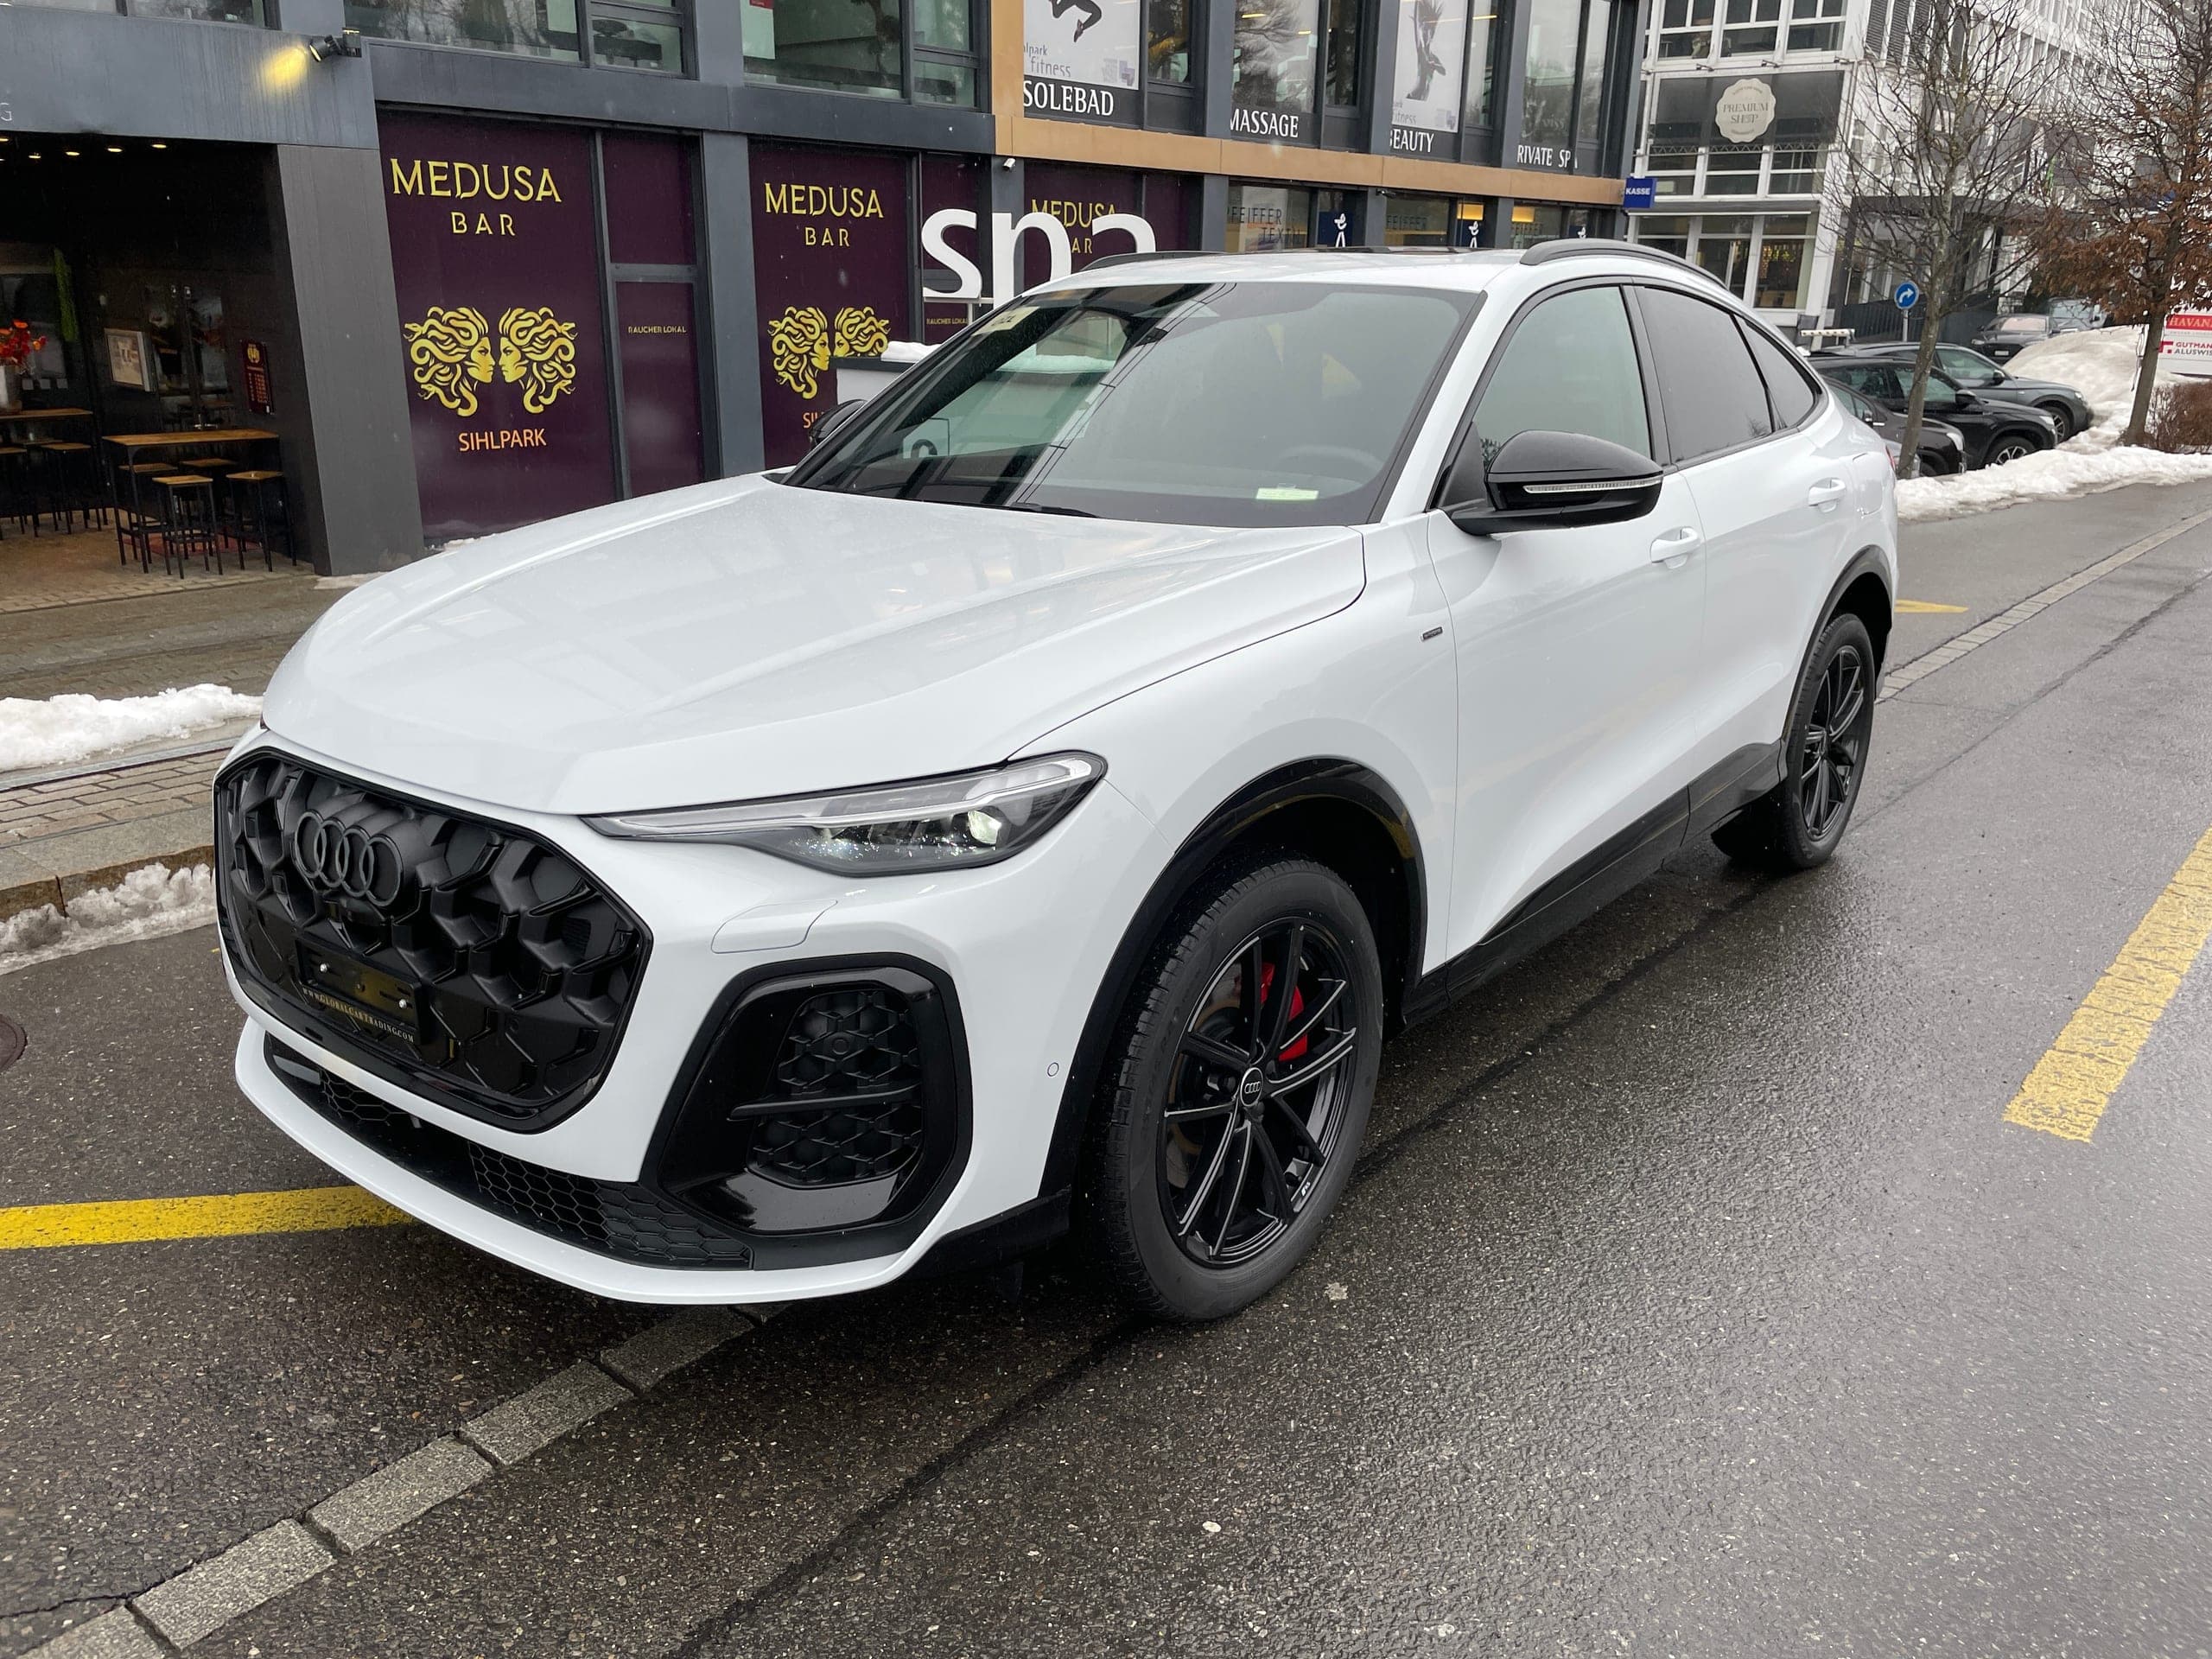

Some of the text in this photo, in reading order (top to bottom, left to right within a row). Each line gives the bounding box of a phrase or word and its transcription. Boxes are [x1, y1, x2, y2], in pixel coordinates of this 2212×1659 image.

[1031, 56, 1071, 78] fitness
[1024, 80, 1114, 116] SOLEBAD
[1723, 102, 1769, 113] PREMIUM
[1230, 108, 1299, 138] MASSAGE
[1516, 144, 1578, 169] RIVATE SP
[391, 158, 562, 202] MEDUSA
[1625, 187, 1651, 195] KASSE
[765, 182, 884, 218] MEDUSA
[451, 212, 516, 236] BAR
[1227, 207, 1282, 225] FEIFFER
[804, 226, 850, 247] BAR
[458, 428, 547, 451] SIHLPARK
